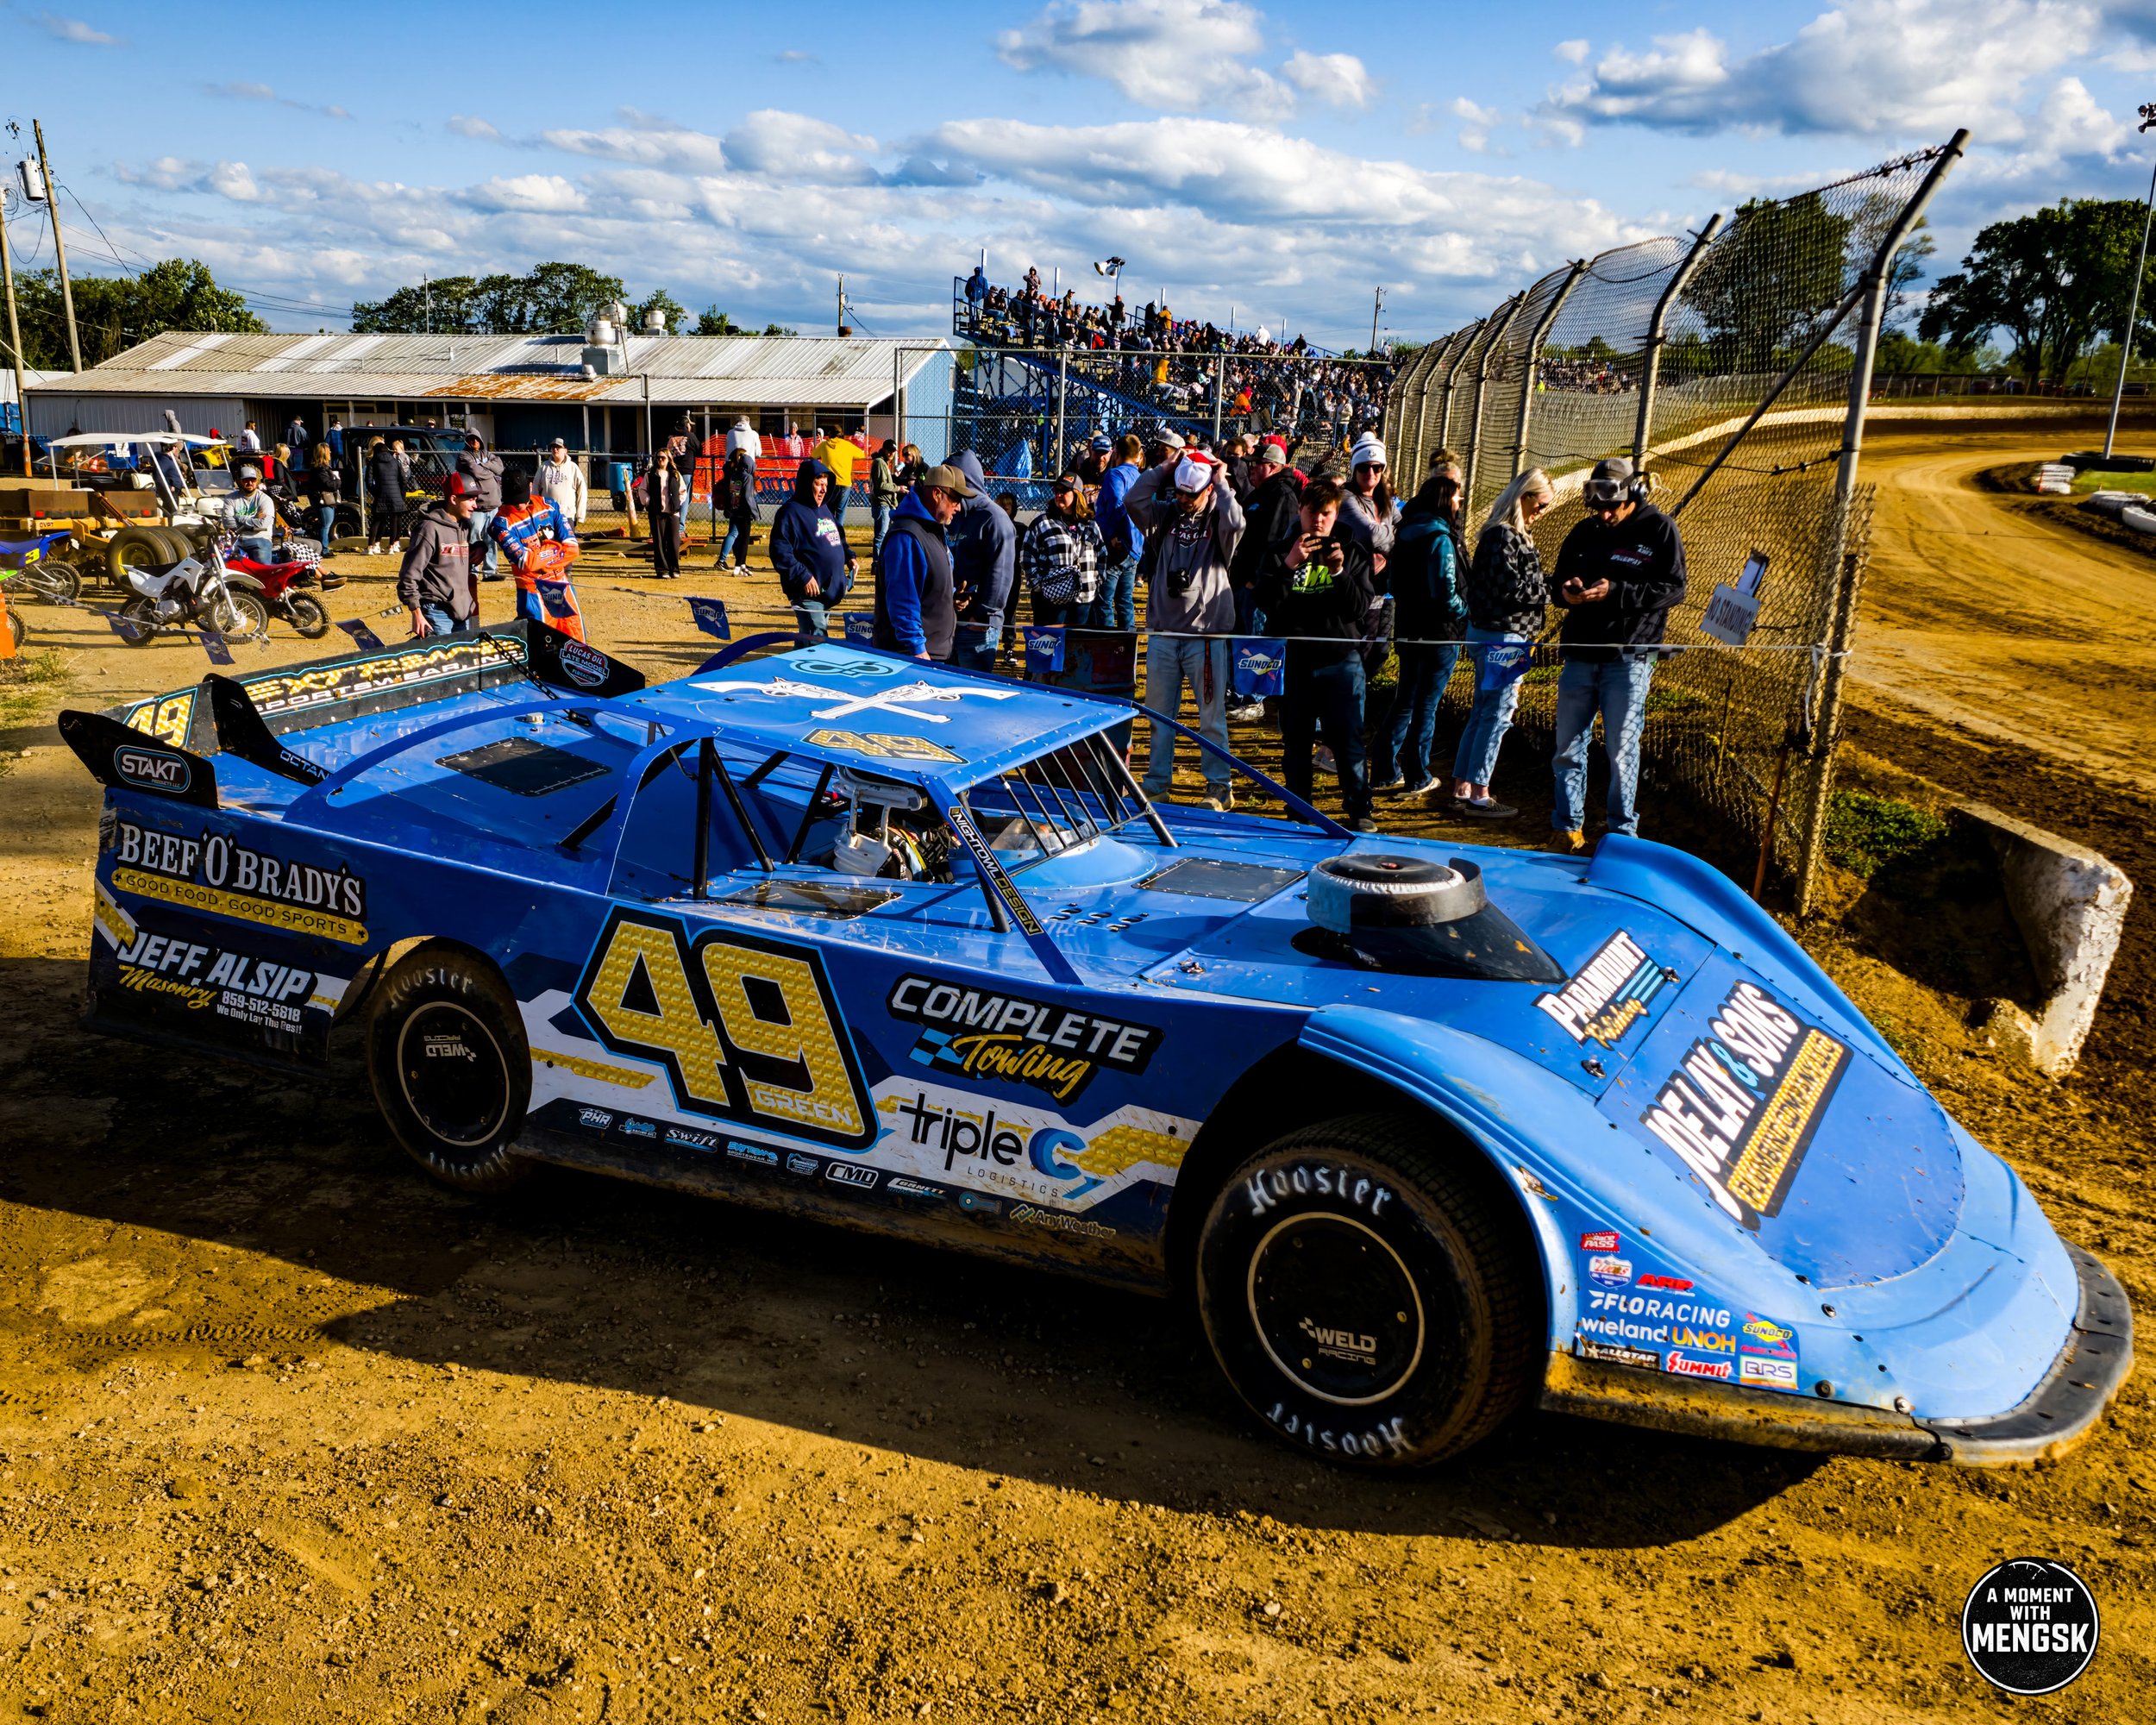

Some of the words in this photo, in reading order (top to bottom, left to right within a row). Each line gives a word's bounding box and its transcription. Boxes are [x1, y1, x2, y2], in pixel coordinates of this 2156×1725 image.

[25, 549, 40, 565] 3
[1704, 594, 1723, 621] NO
[561, 650, 580, 663] LATE
[581, 658, 607, 676] MODEL
[569, 645, 591, 660] LUCAS
[592, 654, 603, 665] OIL
[1239, 659, 1281, 669] SUNOCO
[126, 694, 192, 748] 49
[808, 729, 964, 763] 49
[122, 754, 181, 781] STAKT
[117, 823, 199, 876] BEEF
[232, 848, 362, 916] BRADY'S
[126, 875, 169, 894] GOOD
[175, 887, 222, 907] FOOD,
[229, 900, 275, 919] GOOD
[282, 910, 348, 935] SPORTS
[117, 932, 210, 976] JEFF
[205, 950, 312, 1000] ALSIP
[118, 965, 216, 1009] Masonry
[389, 967, 474, 1010] Hoosier
[1537, 930, 1646, 1042] PARAMOUNT
[216, 1003, 229, 1016] We
[230, 1007, 248, 1021] Only
[249, 1012, 263, 1026] Lay
[265, 1016, 279, 1029] The
[222, 990, 301, 1022] 859-512-5818
[891, 977, 1150, 1063] COMPLETE
[586, 919, 866, 1137] 49
[1712, 983, 1800, 1077] SONS
[426, 1043, 467, 1058] WELD
[952, 1032, 1091, 1100] Towing
[1709, 1041, 1758, 1088] &
[755, 1088, 854, 1127] GREEN
[1674, 1044, 1757, 1141] LAY
[581, 1111, 612, 1126] PHR
[1737, 1122, 1793, 1203] PLUMBING
[1773, 1061, 1824, 1131] COMPANY
[667, 1129, 717, 1146] Swift
[1644, 1088, 1742, 1222] JOE
[826, 1163, 877, 1184] CMD
[967, 1167, 1059, 1198] LOGISTICS
[1245, 1164, 1392, 1217] Hoosier
[1035, 1209, 1116, 1239] AnyWeather
[1584, 1239, 1615, 1249] PASS
[1637, 1273, 1695, 1291] ARP
[1603, 1293, 1731, 1328] FLORACING
[1314, 1327, 1377, 1354] WELD
[1582, 1317, 1669, 1343] wieland
[1671, 1325, 1736, 1353] UNOH
[1745, 1325, 1790, 1339] SUNOCO
[1318, 1347, 1376, 1366] RACING
[1600, 1348, 1657, 1362] ALLSTAR
[1745, 1360, 1793, 1379] BRS
[1265, 1401, 1418, 1458] Hoosier
